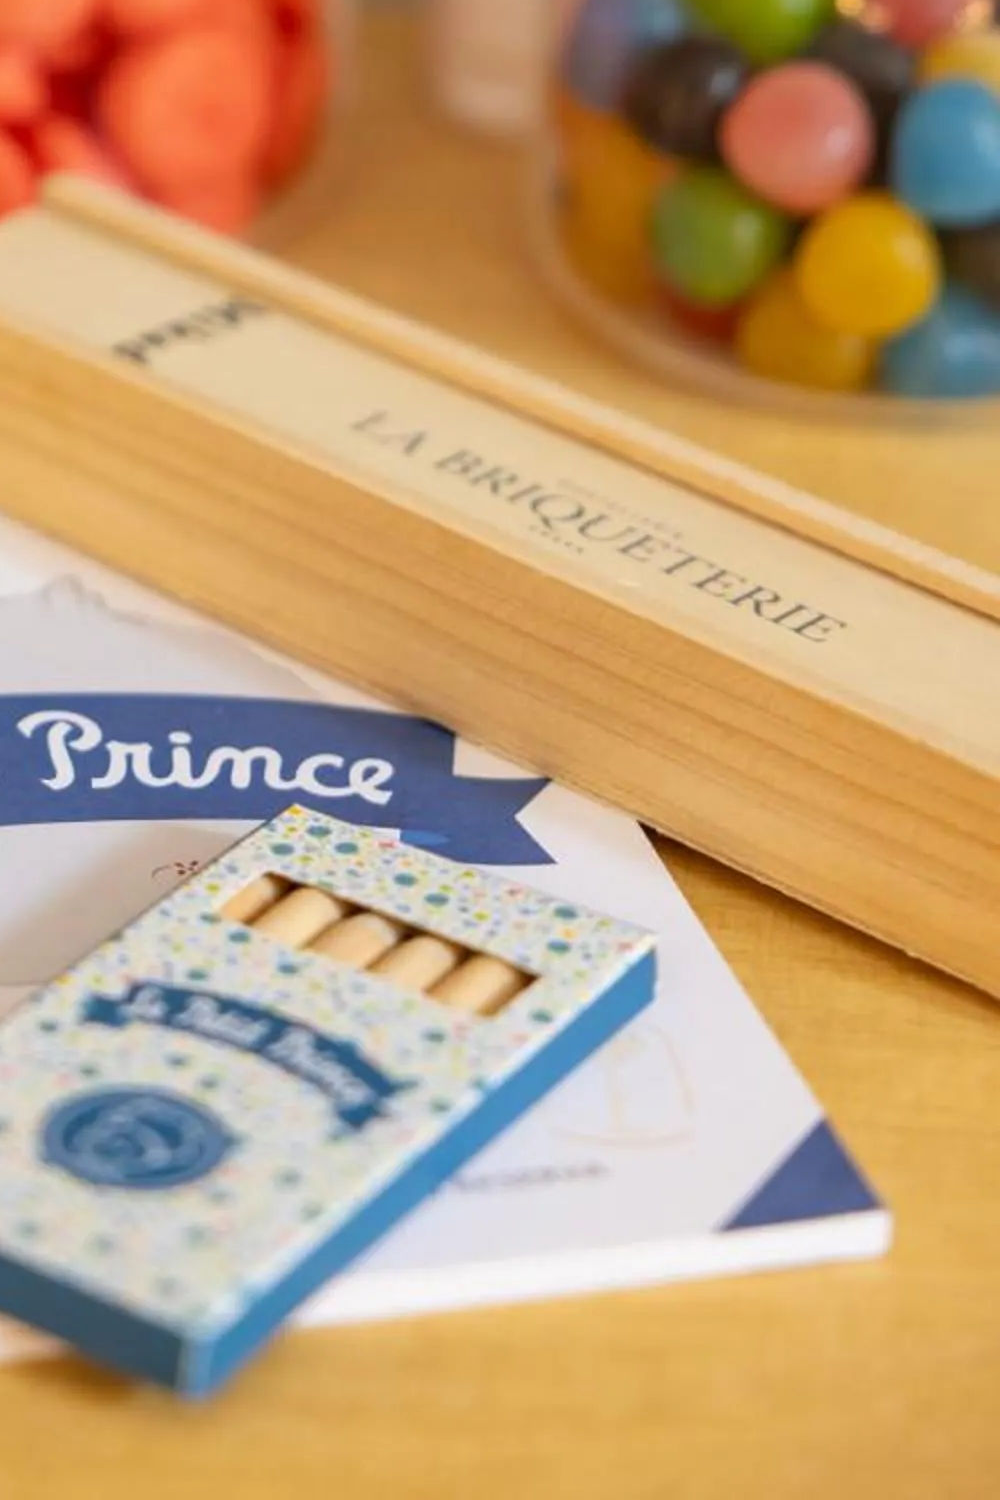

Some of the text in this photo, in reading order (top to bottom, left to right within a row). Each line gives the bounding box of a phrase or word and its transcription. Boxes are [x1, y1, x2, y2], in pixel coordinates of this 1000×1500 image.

[350, 409, 430, 457] LA
[433, 447, 848, 644] BRIQUETERIE
[16, 709, 395, 806] Prince
[172, 995, 273, 1046] Petit
[265, 1024, 378, 1107] Prince
